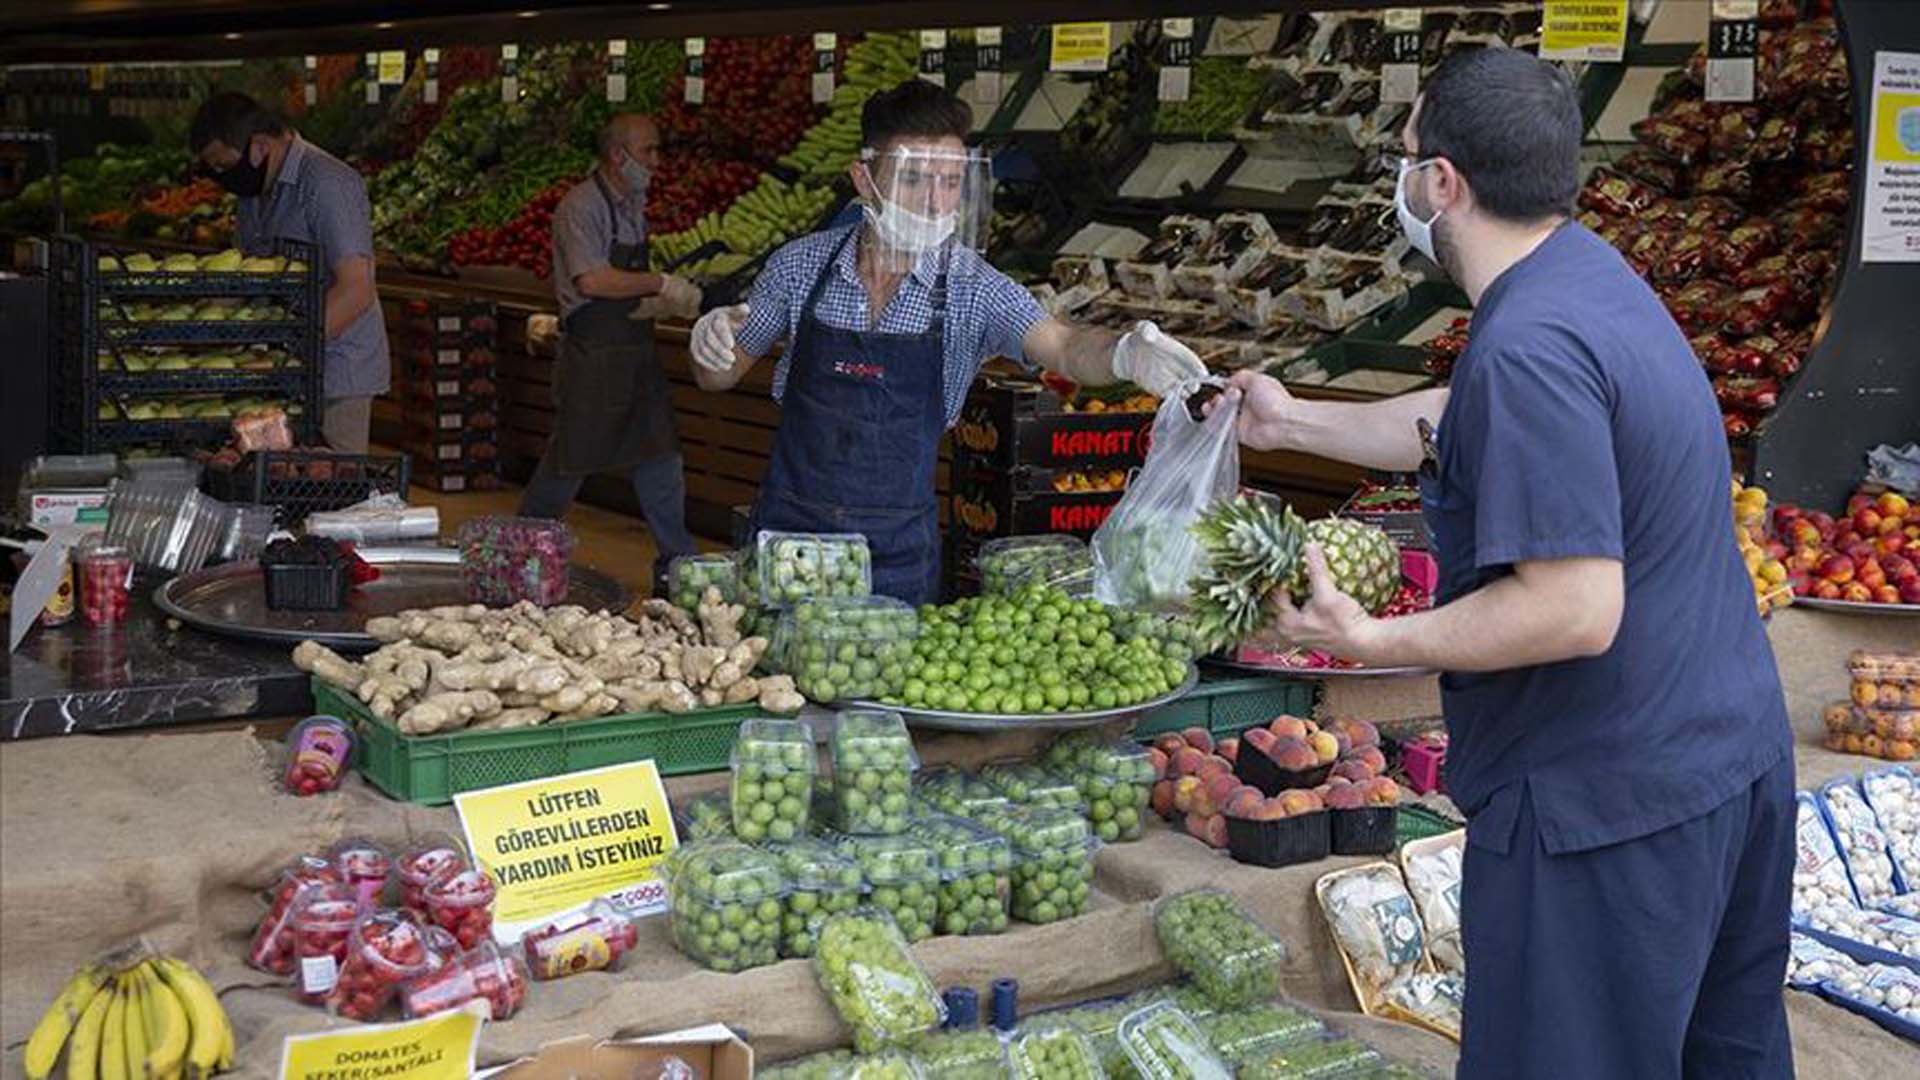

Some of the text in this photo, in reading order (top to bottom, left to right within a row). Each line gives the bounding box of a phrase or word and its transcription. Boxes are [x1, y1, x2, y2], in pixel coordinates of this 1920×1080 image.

[1051, 429, 1133, 457] KANAT
[1050, 504, 1114, 530] KANA
[528, 788, 602, 818] LÜTFEN
[494, 807, 650, 854] GÖREVLİLERDEN
[494, 852, 573, 886] YARDIM
[575, 832, 664, 870] İSTEYİNİZ
[336, 1040, 422, 1066] DOMATES
